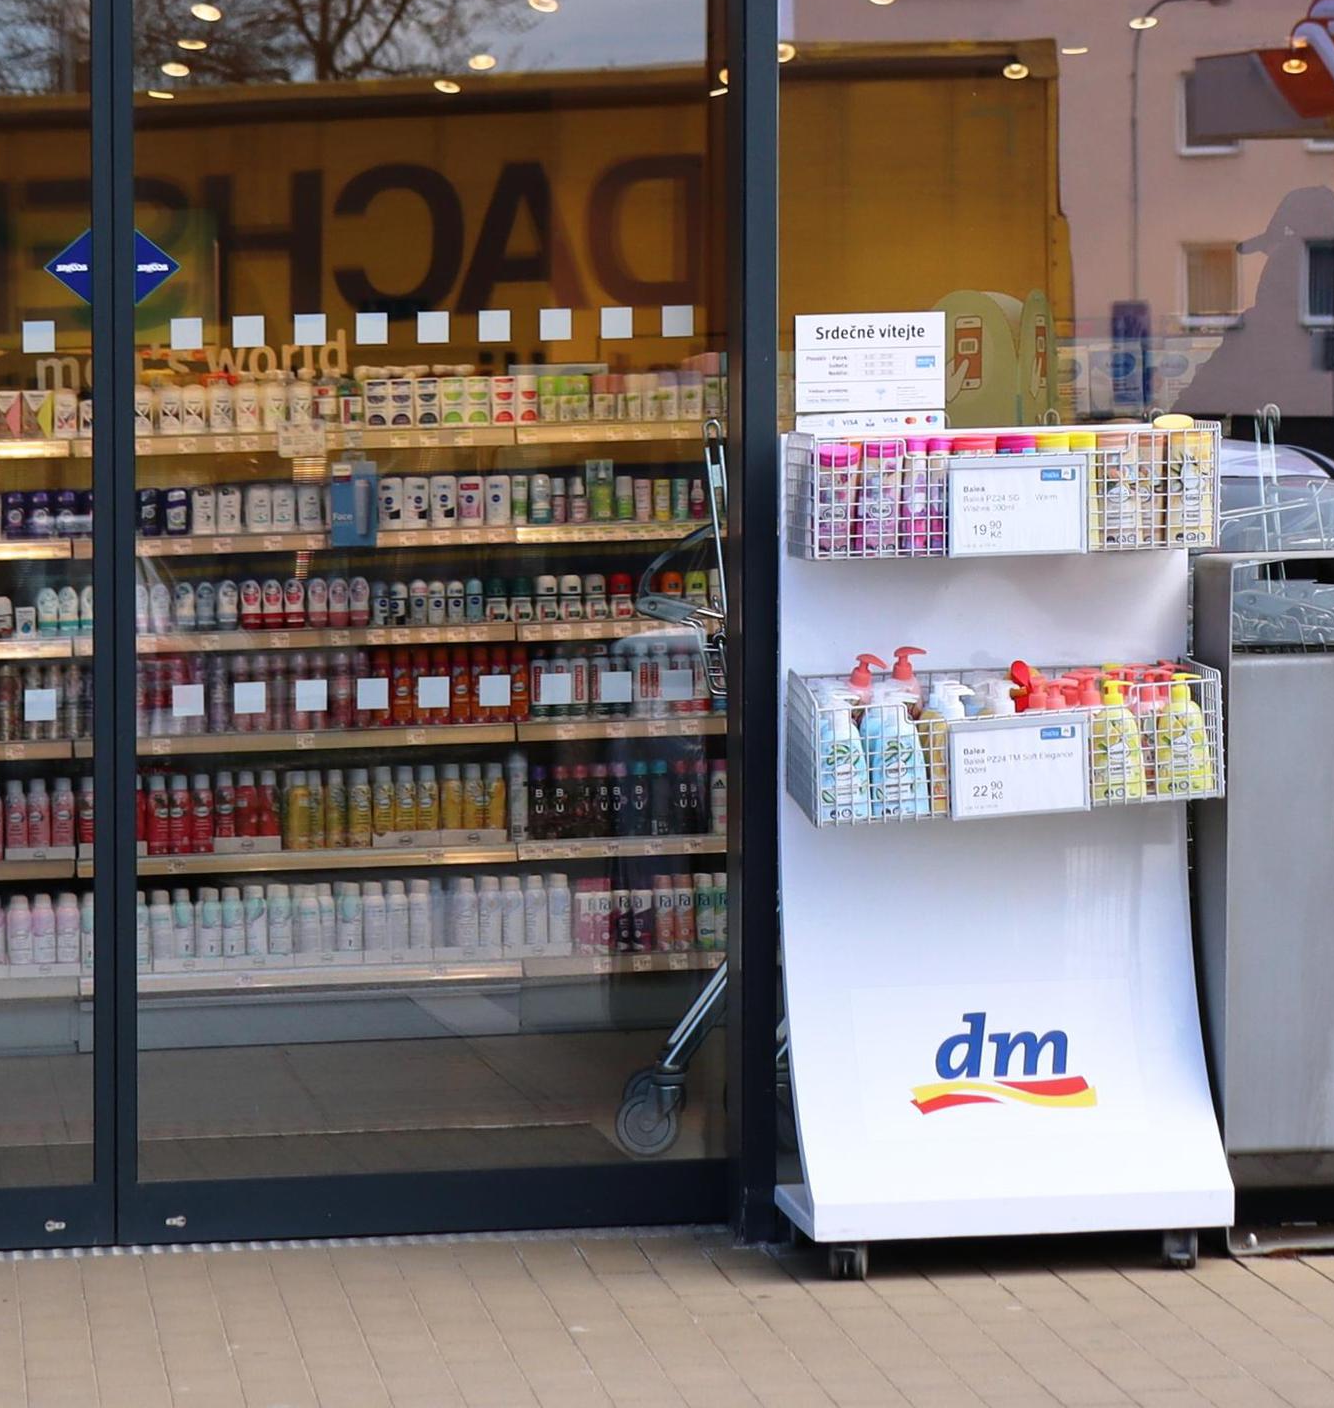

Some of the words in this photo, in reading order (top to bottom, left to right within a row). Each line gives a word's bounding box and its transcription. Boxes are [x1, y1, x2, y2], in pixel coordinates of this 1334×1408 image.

[815, 324, 875, 340] Srdečně
[879, 323, 925, 340] vítejte
[204, 329, 347, 379] world
[973, 524, 987, 535] 19
[989, 520, 1002, 529] 90
[1039, 751, 1073, 760] Elegance
[973, 786, 988, 797] 22
[991, 781, 1003, 790] 90
[992, 790, 1003, 800] Kč
[935, 1012, 1068, 1080] dm
